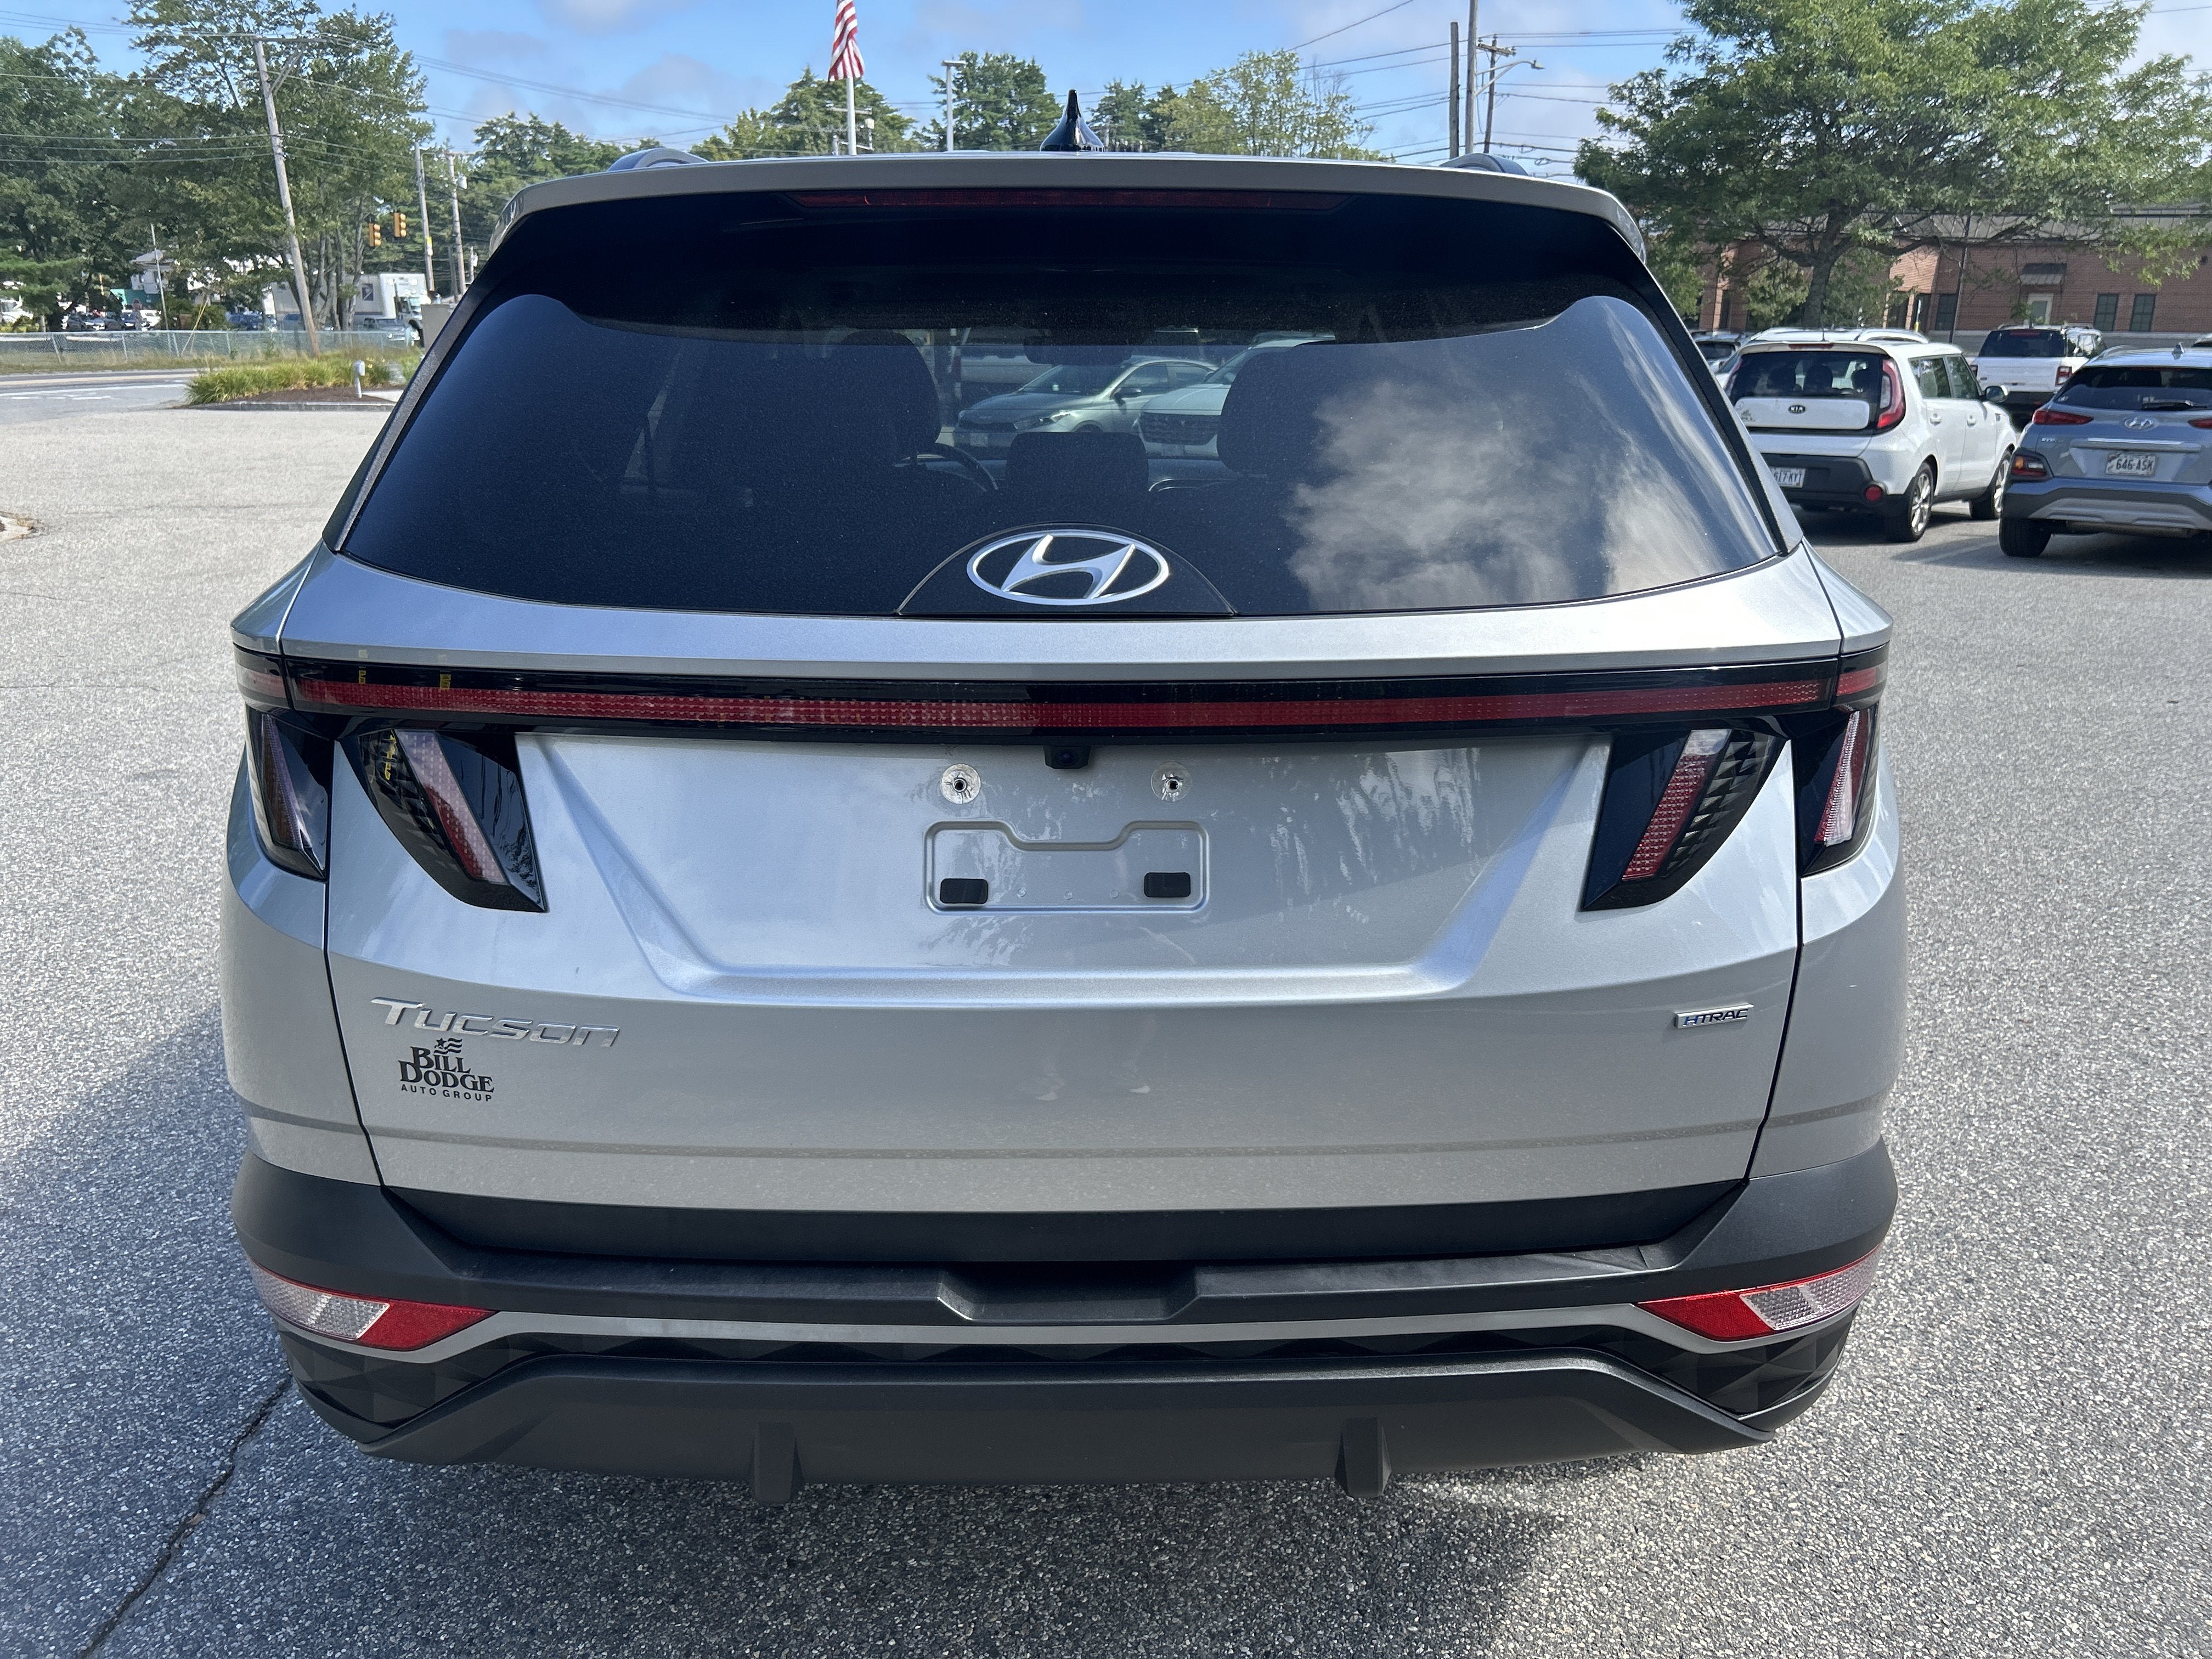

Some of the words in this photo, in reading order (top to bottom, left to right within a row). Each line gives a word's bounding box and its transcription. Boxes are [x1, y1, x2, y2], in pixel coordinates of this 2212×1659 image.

[371, 996, 620, 1047] TUCSON
[1684, 1009, 1748, 1025] HTRAC
[410, 1046, 471, 1074] BILL
[398, 1060, 494, 1093] DODGE
[401, 1084, 437, 1096] AUTO
[443, 1090, 492, 1102] GROUP
